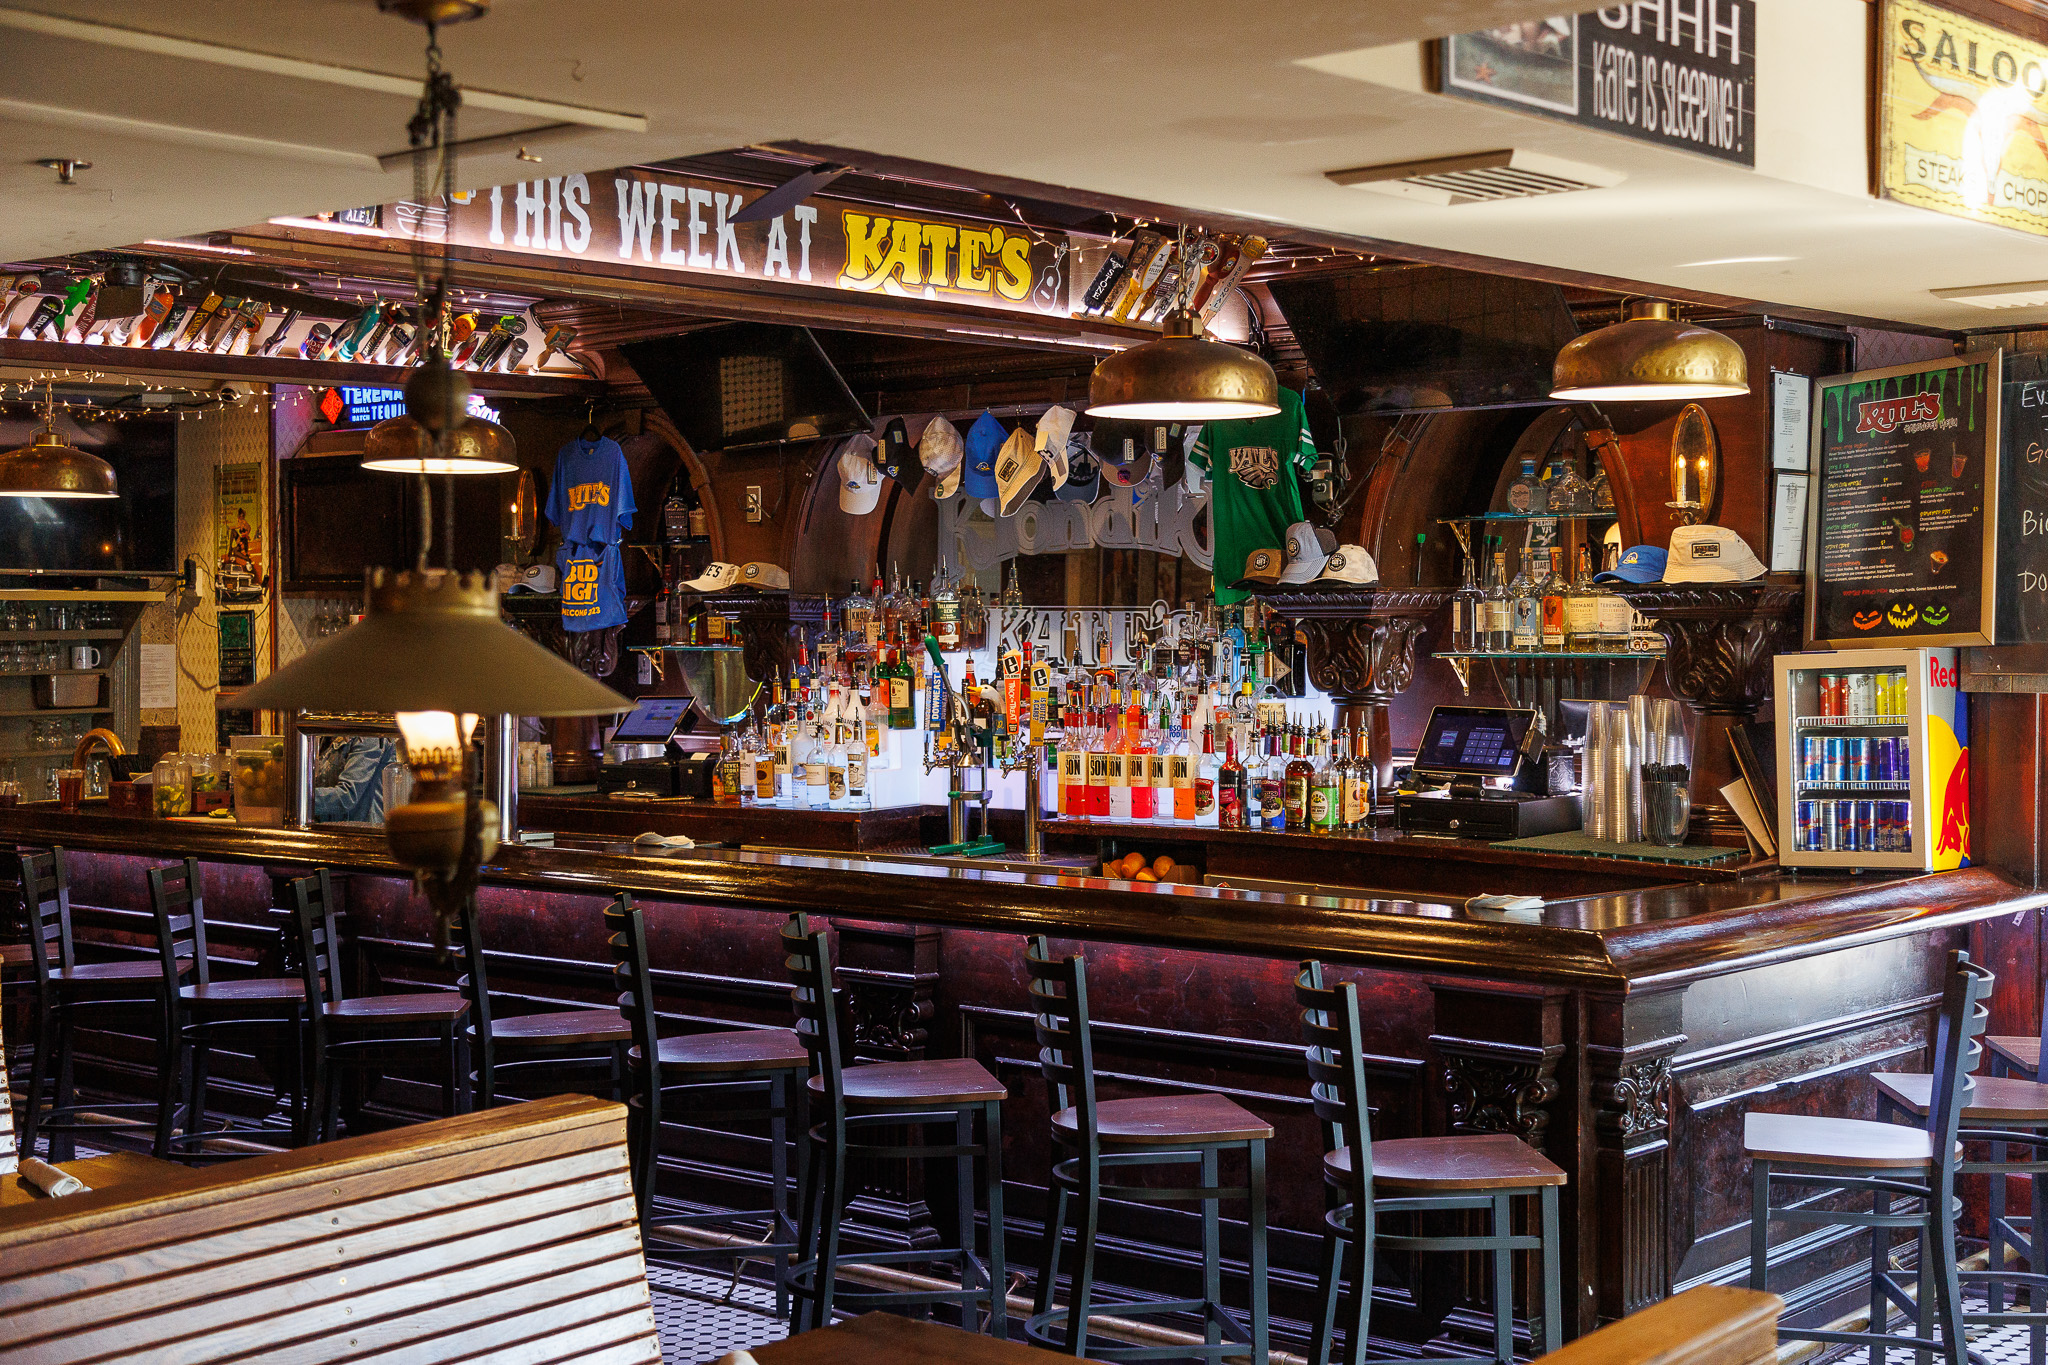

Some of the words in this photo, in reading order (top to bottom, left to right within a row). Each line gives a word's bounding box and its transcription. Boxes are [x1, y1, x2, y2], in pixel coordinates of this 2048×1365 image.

[1642, 55, 1658, 132] IS
[615, 178, 746, 274] WEEK
[763, 203, 818, 282] AT
[837, 211, 1034, 302] KATE'S
[1092, 268, 1116, 300] STONE
[1213, 265, 1244, 309] SEASONAL
[1856, 392, 1941, 434] KATE'S
[1229, 446, 1279, 473] KATE'S
[565, 564, 599, 583] BUD
[1515, 627, 1535, 635] TEQUILA
[1930, 656, 1957, 688] Red
[932, 672, 941, 720] DOWNEAST
[1091, 760, 1107, 776] SON
